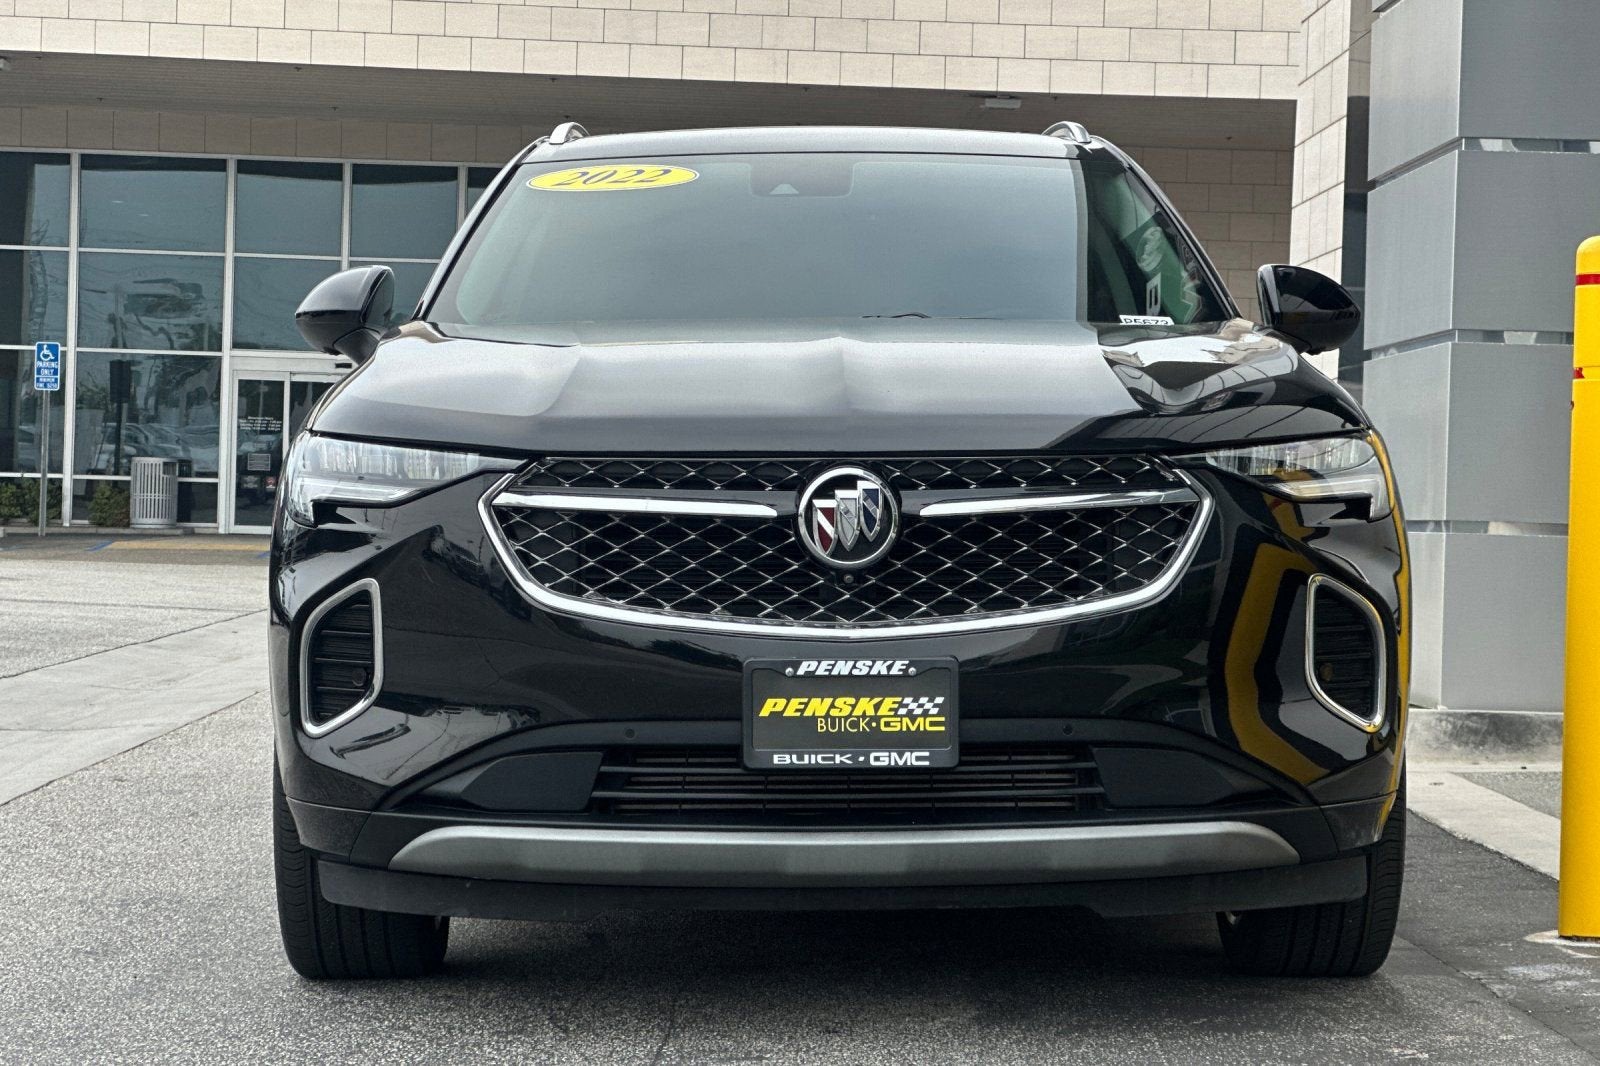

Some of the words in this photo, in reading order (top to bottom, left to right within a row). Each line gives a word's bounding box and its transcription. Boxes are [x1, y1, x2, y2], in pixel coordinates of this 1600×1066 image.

[551, 168, 672, 186] 2022
[796, 660, 910, 676] PENSKE
[758, 697, 903, 717] PENSKE
[817, 717, 870, 733] BUICK
[880, 717, 945, 732] GMC
[773, 754, 853, 765] BUICK
[869, 752, 930, 766] GMC
